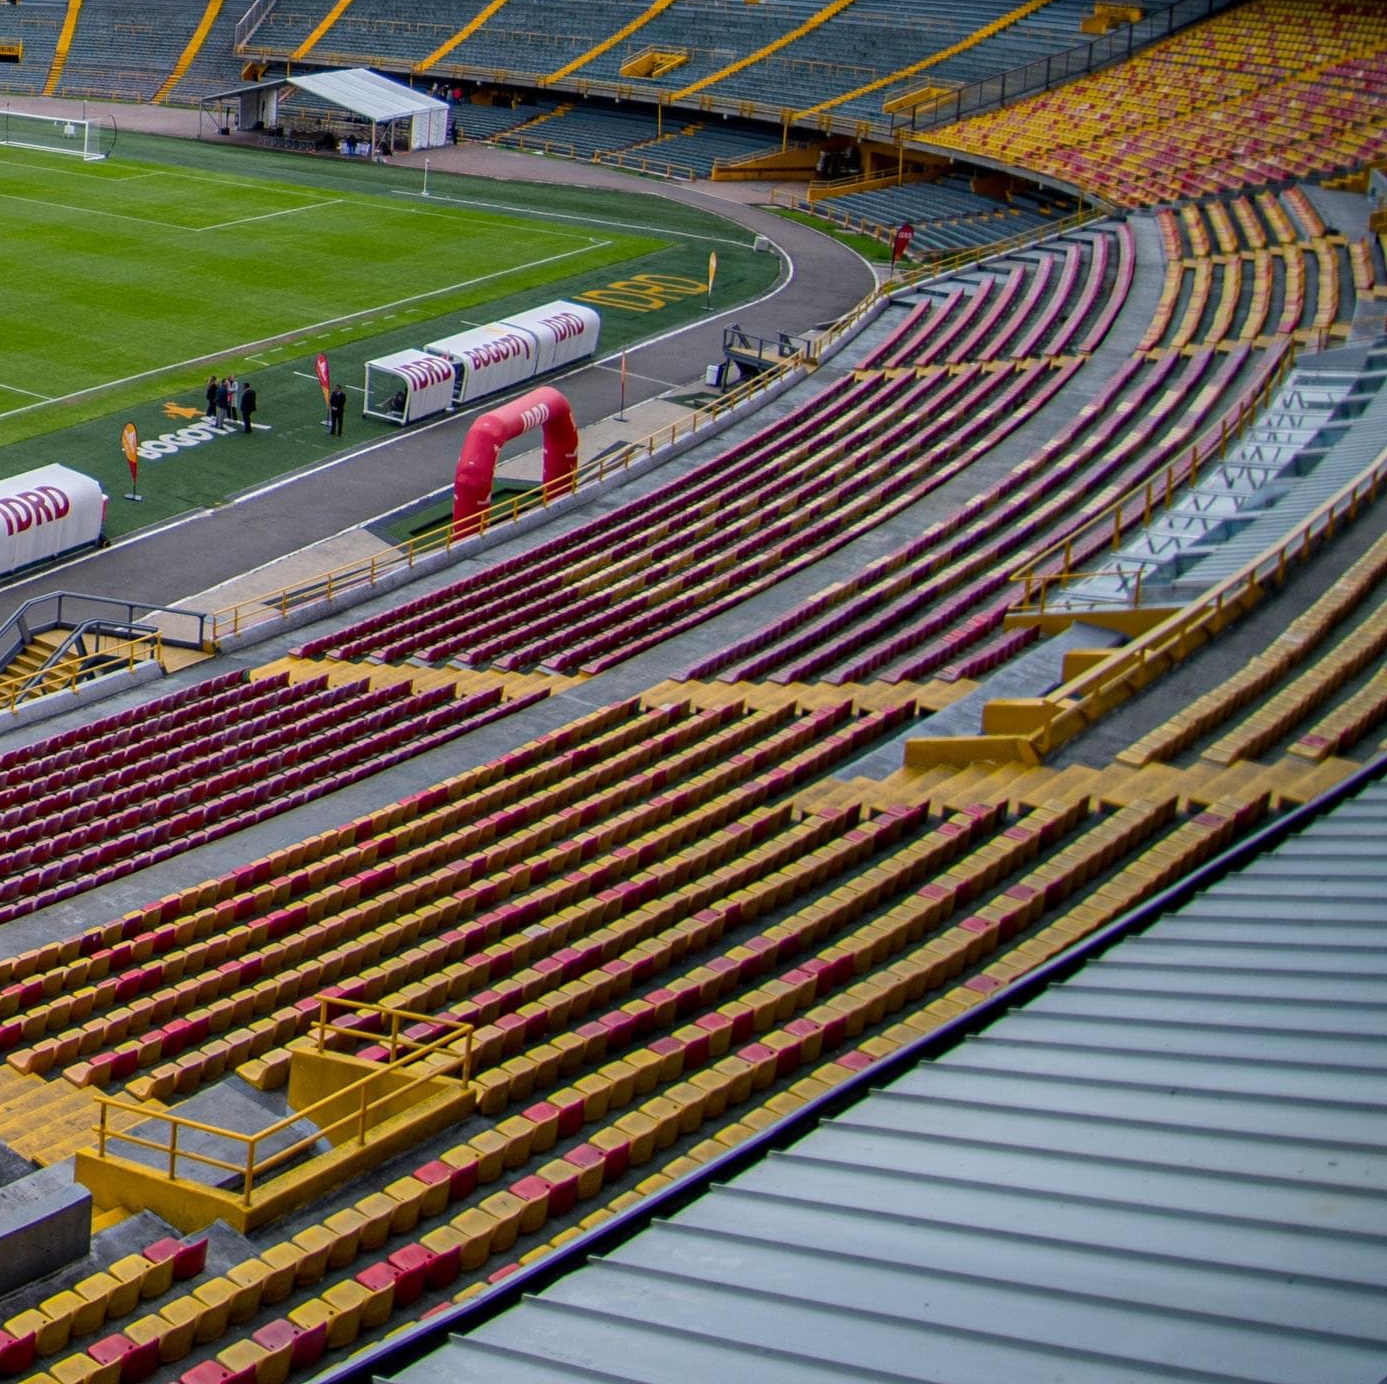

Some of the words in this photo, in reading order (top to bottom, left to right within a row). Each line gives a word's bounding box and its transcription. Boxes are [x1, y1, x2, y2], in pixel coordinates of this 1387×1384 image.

[536, 311, 585, 344] IDRD
[393, 356, 453, 392] IDRD
[520, 402, 550, 432] IDRD
